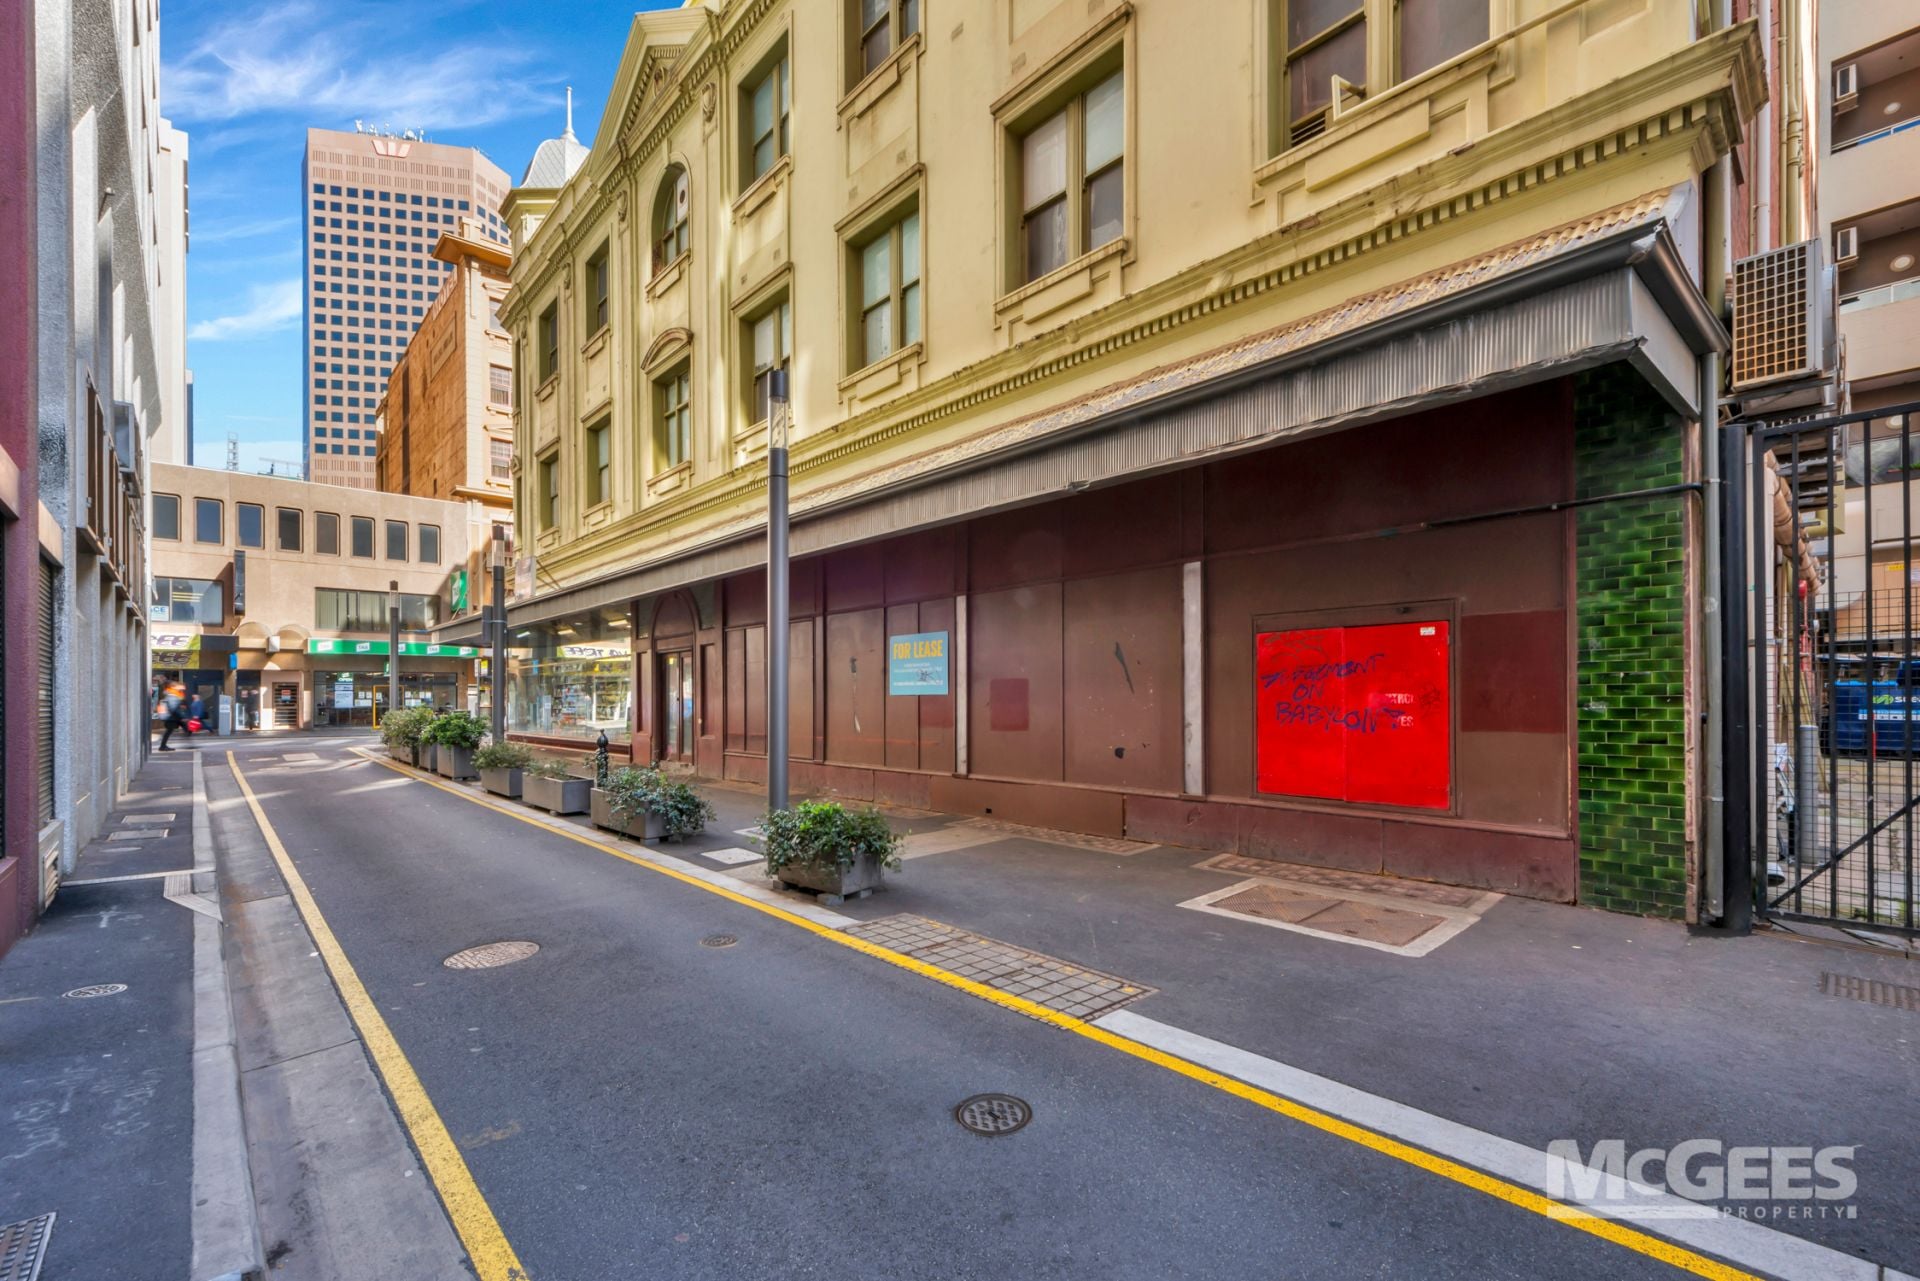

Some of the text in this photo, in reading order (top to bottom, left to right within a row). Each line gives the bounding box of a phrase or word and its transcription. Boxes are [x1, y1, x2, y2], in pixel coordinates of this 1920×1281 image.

[893, 639, 944, 660] FOR LEASE
[1293, 683, 1324, 702] ON
